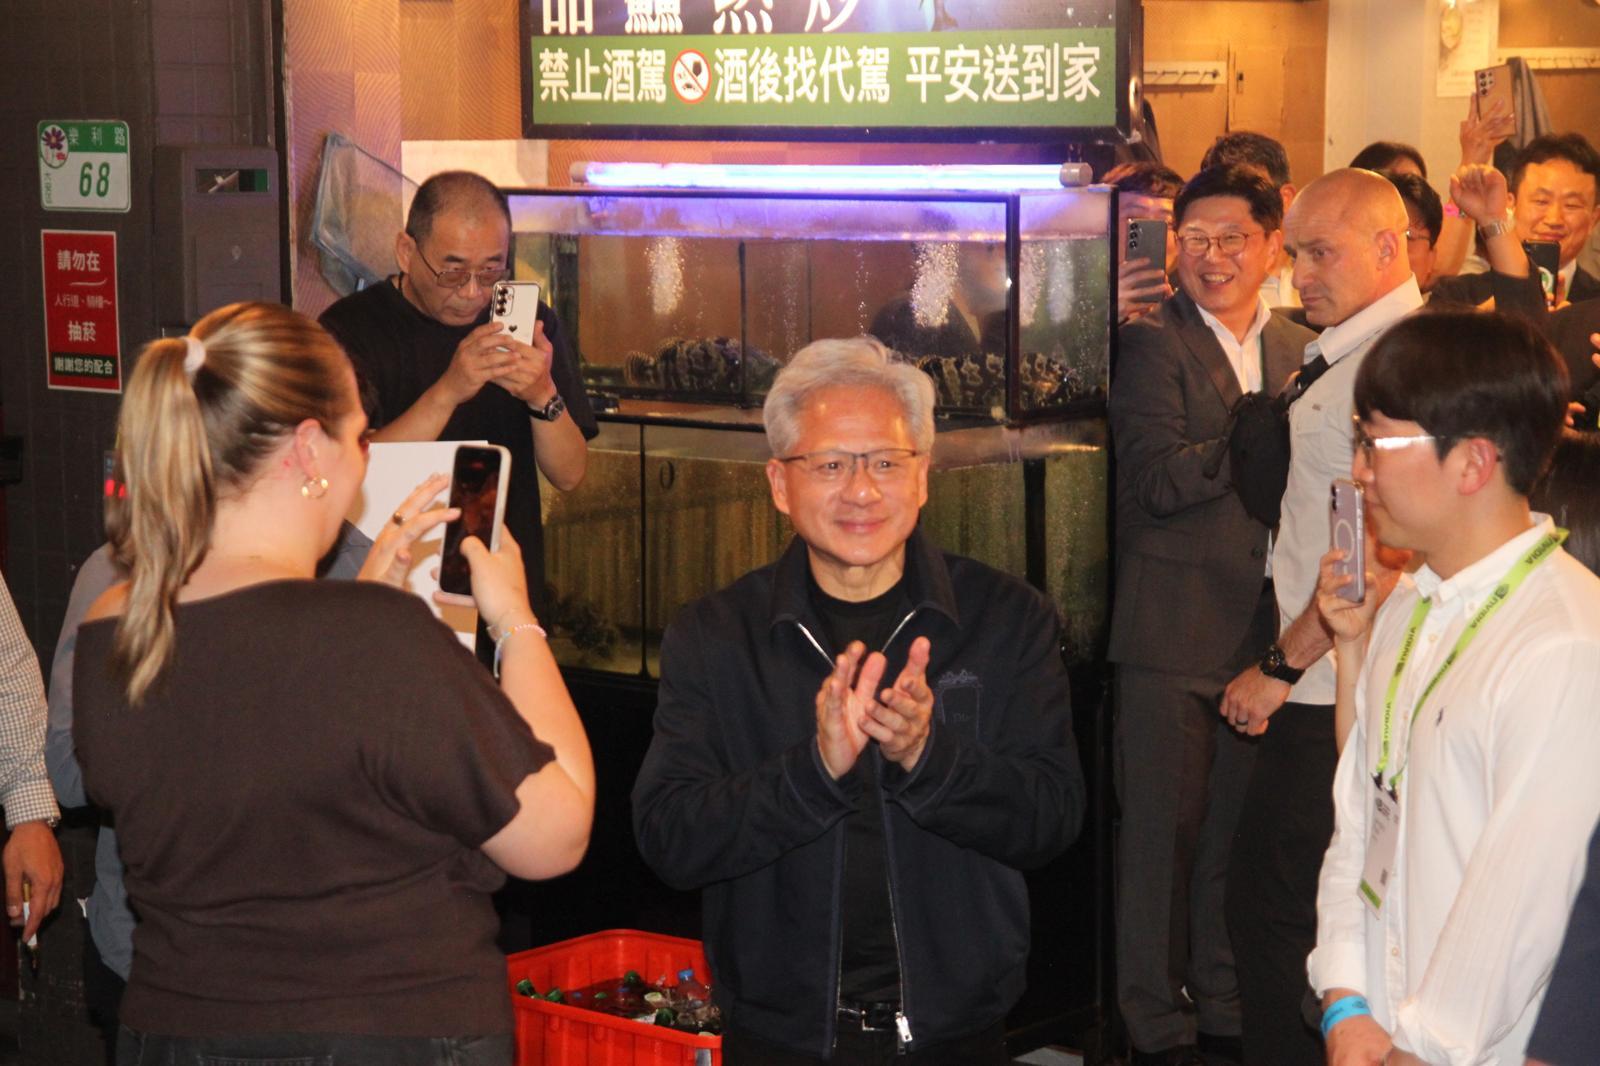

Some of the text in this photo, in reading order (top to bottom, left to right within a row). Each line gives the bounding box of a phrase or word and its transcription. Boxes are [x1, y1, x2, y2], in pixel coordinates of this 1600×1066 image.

[539, 42, 1101, 103] 禁止酒駕 酒後找代駕 平安送到家
[80, 161, 110, 197] 68
[57, 249, 101, 272] 請勿在
[67, 320, 96, 342] 抽菸
[54, 356, 113, 375] 謝謝您的配合
